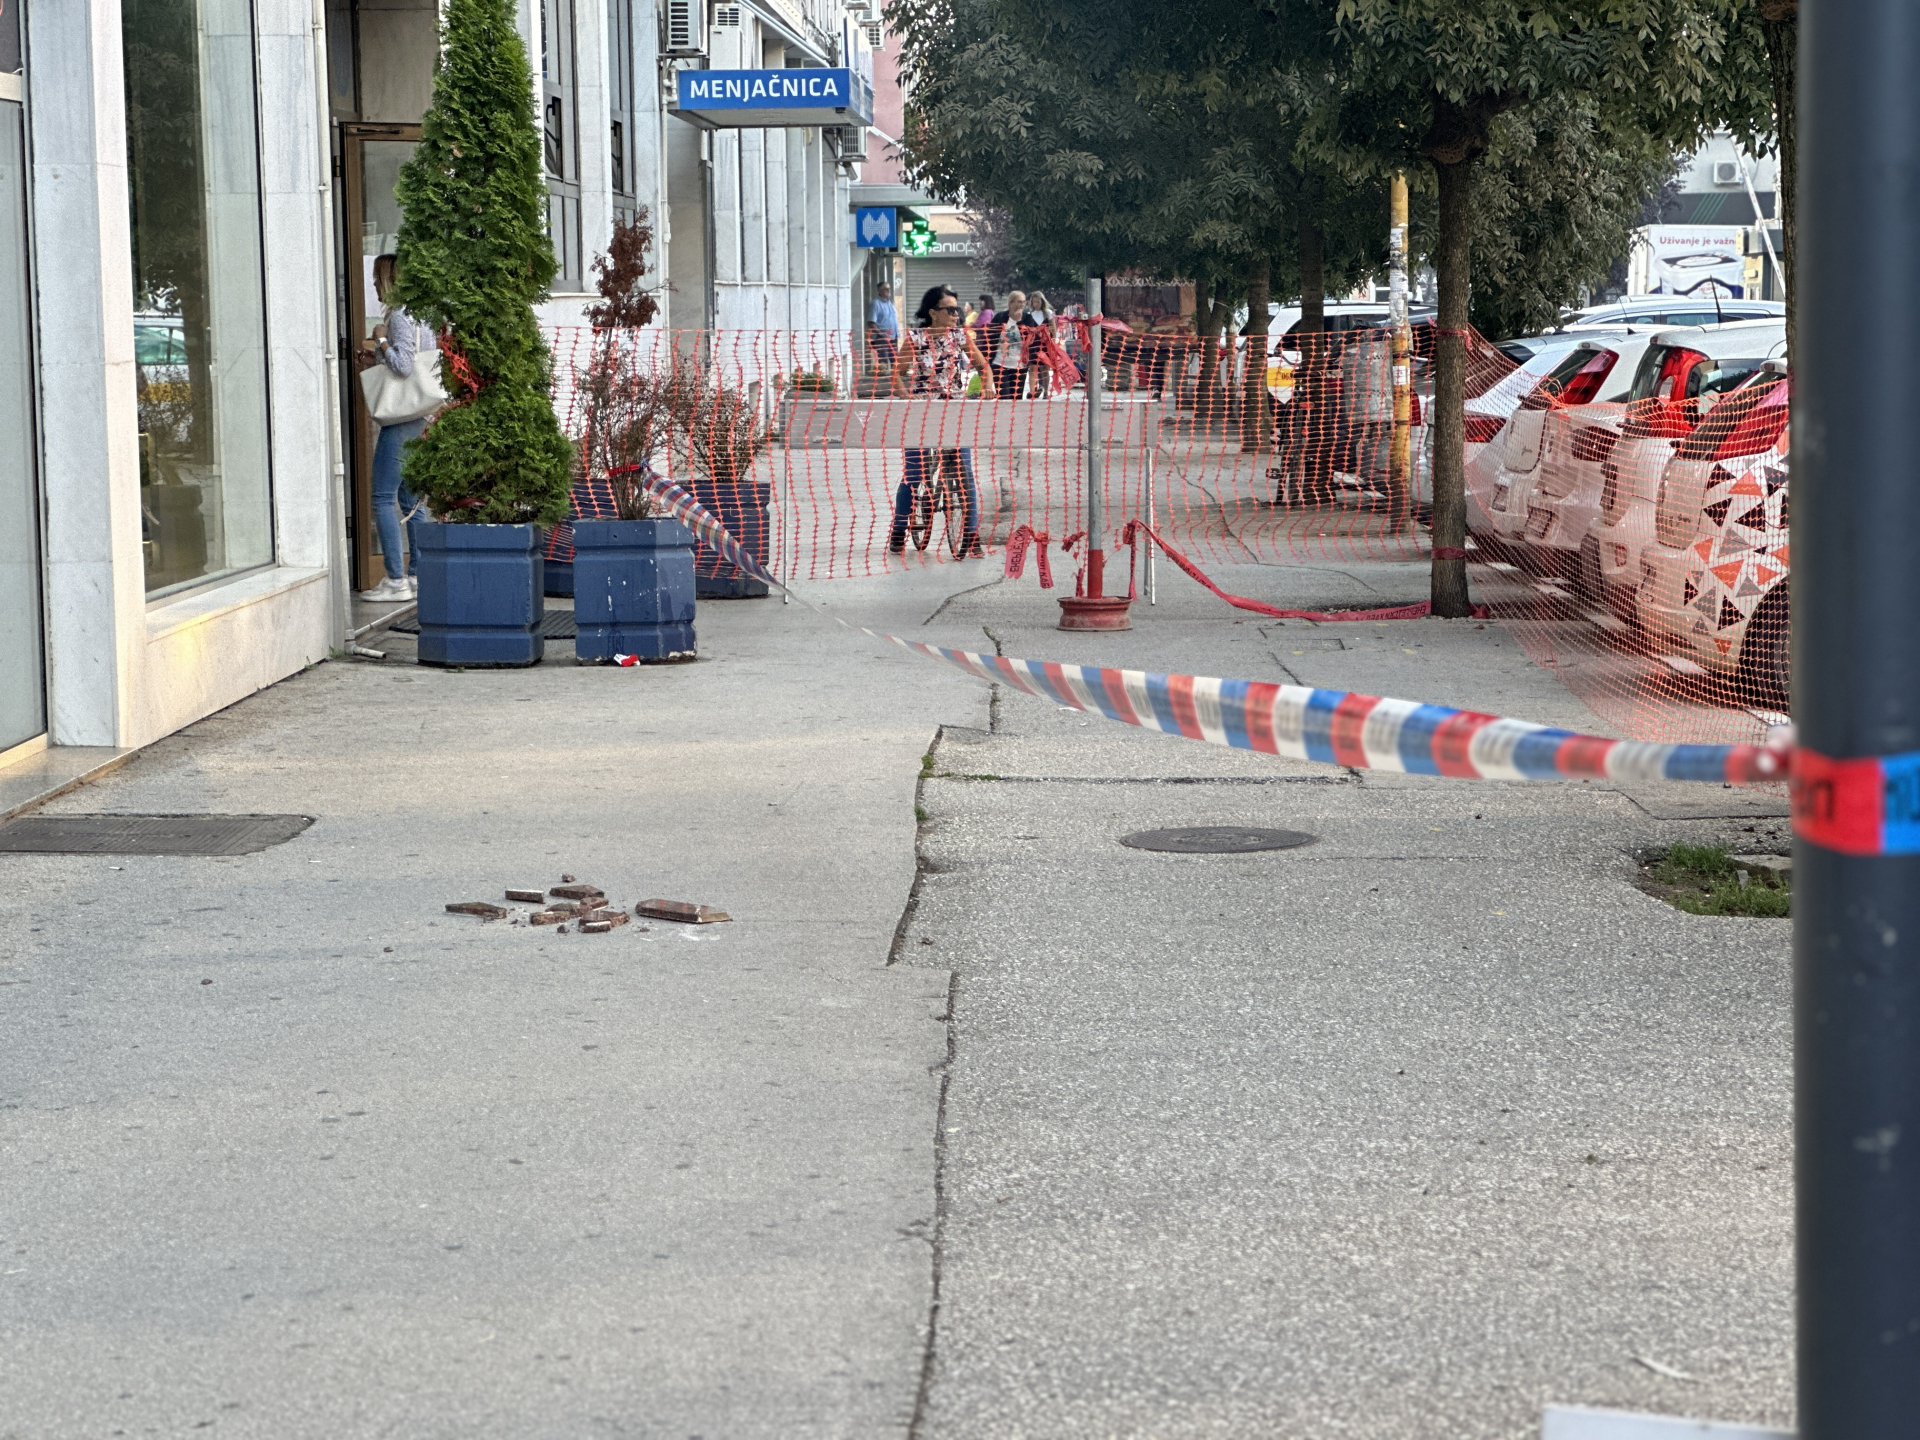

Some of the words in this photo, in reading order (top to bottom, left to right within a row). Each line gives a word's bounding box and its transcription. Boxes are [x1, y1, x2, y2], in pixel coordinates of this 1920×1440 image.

[690, 74, 839, 103] MENJAČNICA
[1659, 236, 1700, 246] Uživanje
[1702, 236, 1711, 246] je
[1713, 236, 1737, 245] važn
